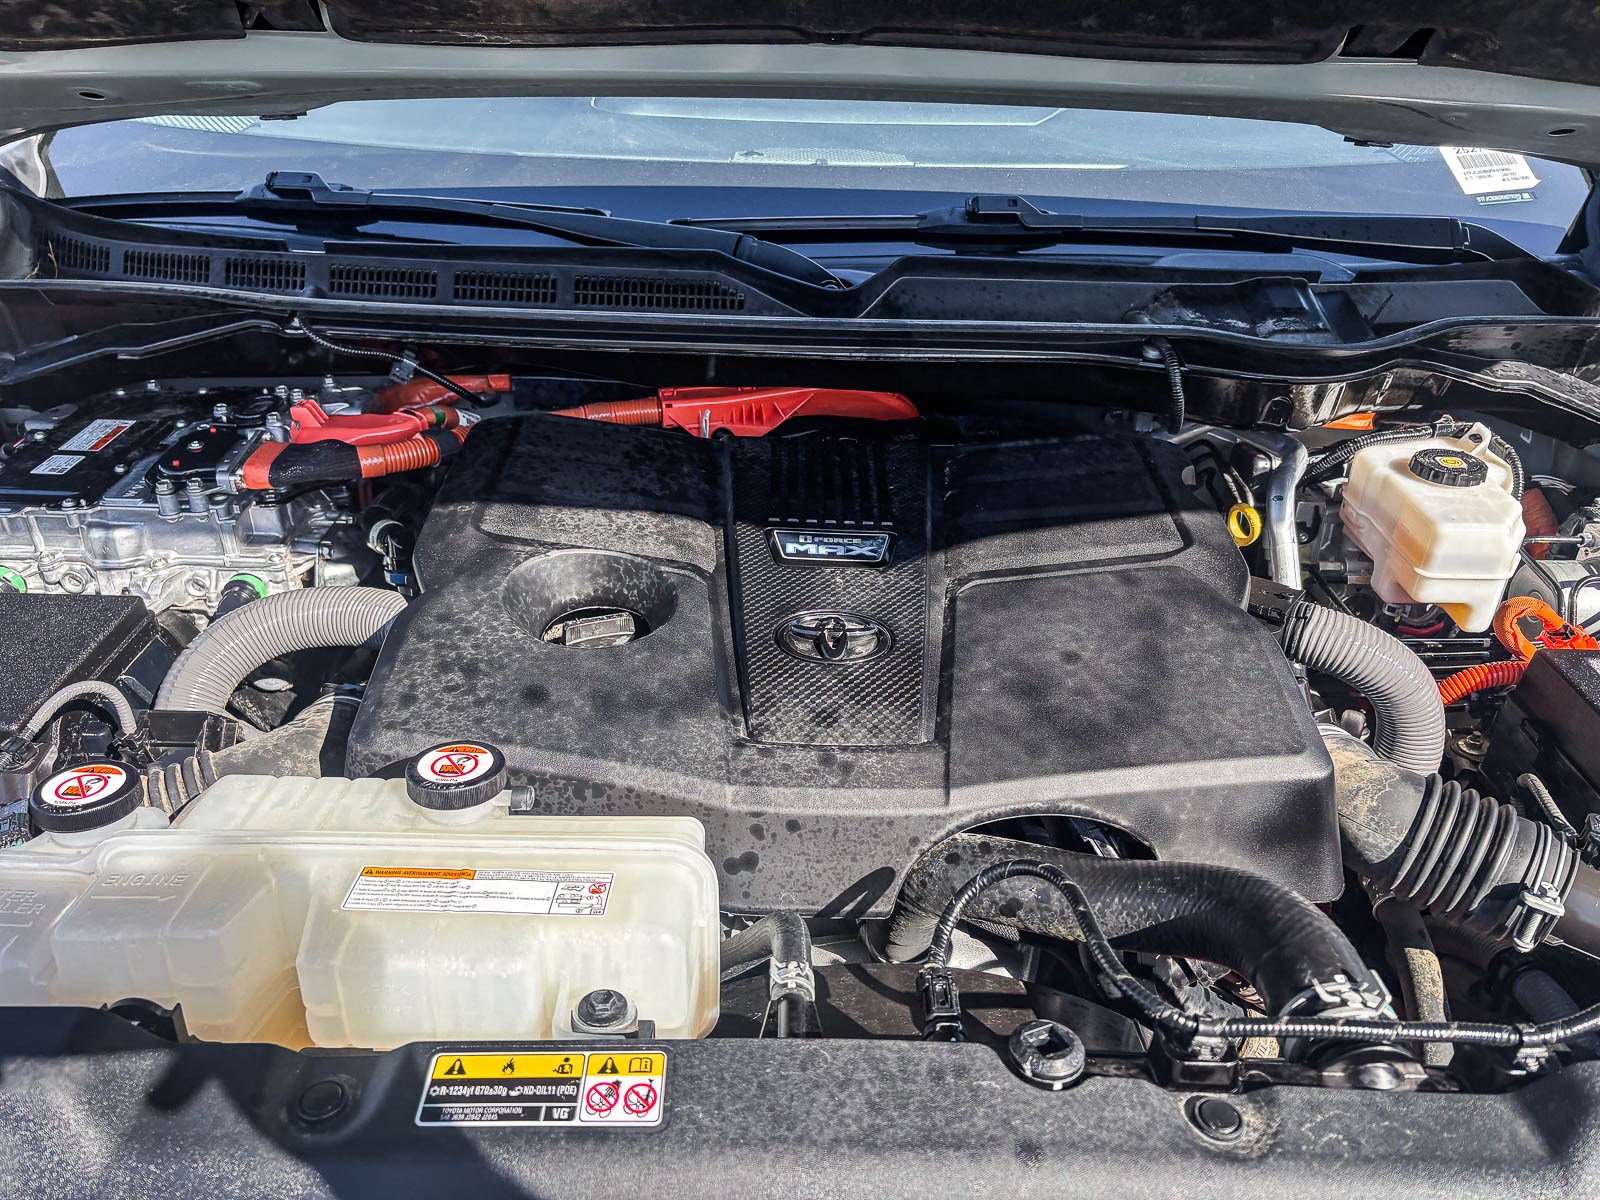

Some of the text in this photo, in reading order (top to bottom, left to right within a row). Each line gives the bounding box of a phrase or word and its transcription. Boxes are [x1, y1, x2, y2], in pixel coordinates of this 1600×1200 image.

[786, 543, 879, 556] MAX
[102, 873, 188, 886] ENGINE
[440, 1085, 475, 1097] R-1234yf
[484, 1107, 523, 1115] CORPORATION
[552, 1107, 570, 1119] VG
